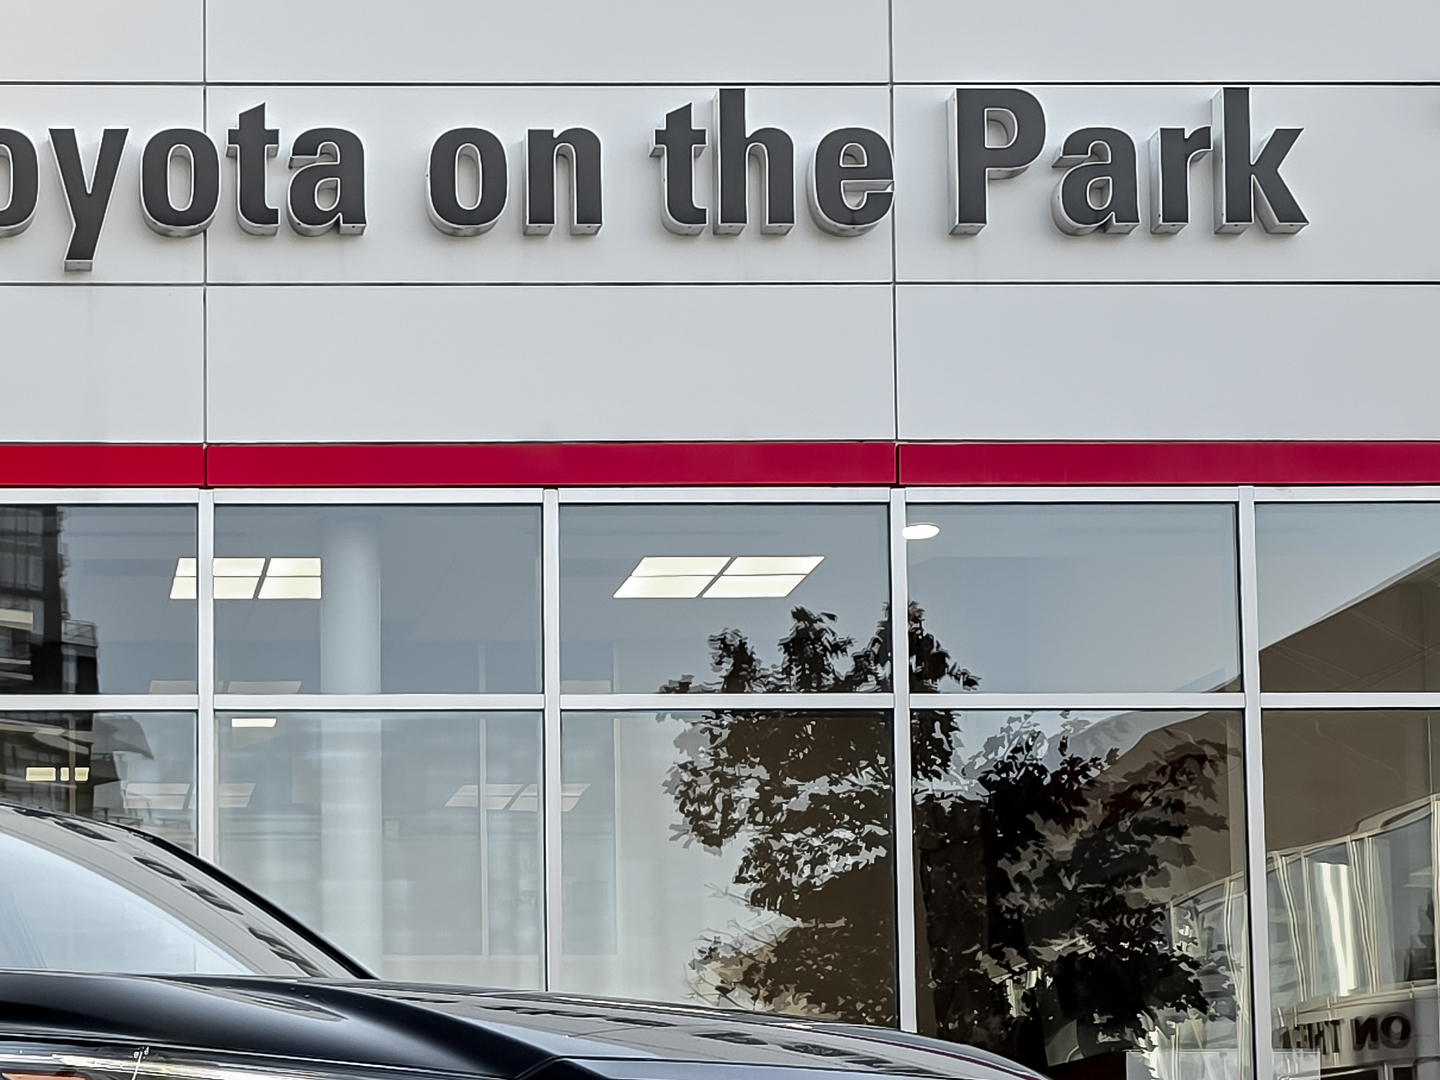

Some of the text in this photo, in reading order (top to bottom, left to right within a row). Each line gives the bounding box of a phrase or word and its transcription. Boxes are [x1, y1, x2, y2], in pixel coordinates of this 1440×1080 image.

[427, 126, 604, 237] on
[649, 87, 895, 237] the
[949, 87, 1310, 236] Park
